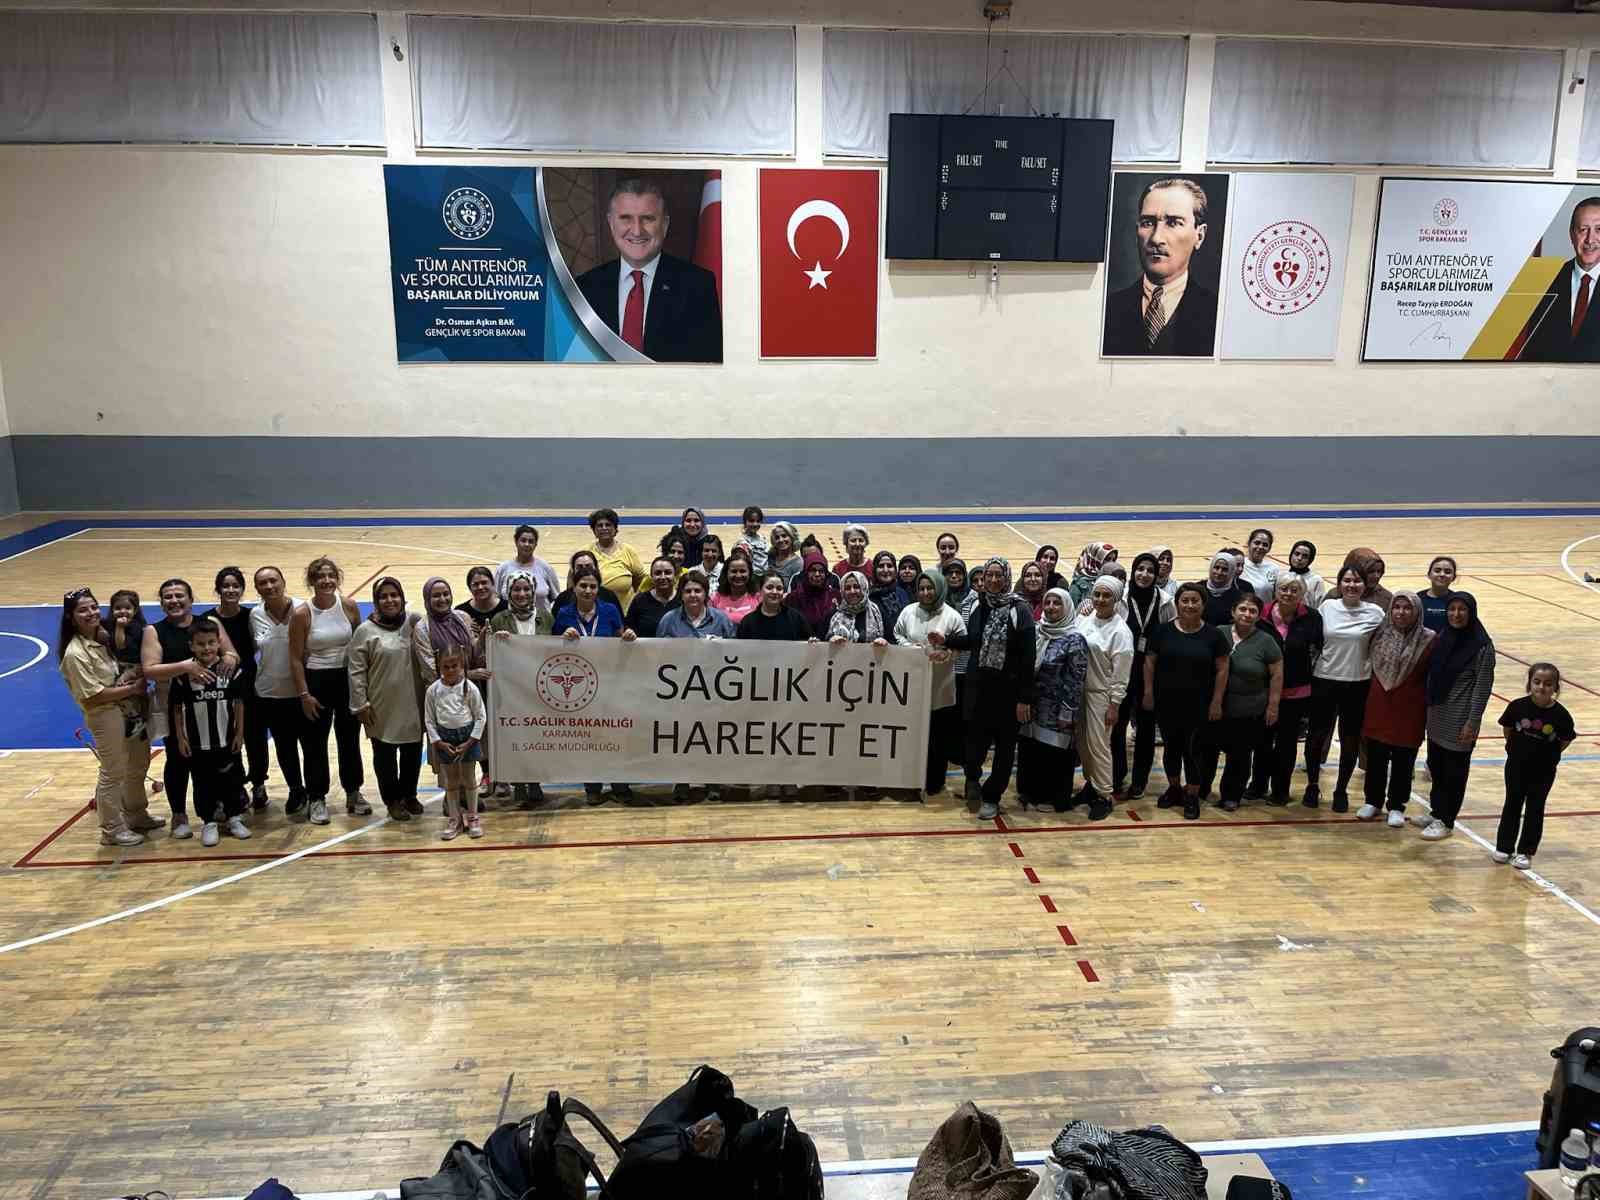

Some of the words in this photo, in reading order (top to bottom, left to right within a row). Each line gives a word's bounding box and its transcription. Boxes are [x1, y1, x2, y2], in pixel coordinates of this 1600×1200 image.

[415, 257, 448, 272] TÜM
[451, 258, 527, 273] ANTRENÖR
[1387, 252, 1412, 266] TÜM
[1415, 253, 1477, 267] ANTRENÖR
[1480, 255, 1494, 267] VE
[400, 273, 418, 286] VE
[421, 273, 544, 287] SPORCULARIMIZA
[1388, 267, 1488, 280] SPORCULARIMIZA
[1380, 281, 1436, 293] BAŞARILAR
[1438, 280, 1493, 292] DİLİYORUM
[407, 290, 472, 302] BAŞARILAR
[474, 288, 540, 301] DİLİYORUM
[1397, 300, 1417, 308] Recep
[1418, 300, 1439, 309] Tayyip
[1440, 299, 1473, 308] ERDOĞAN
[435, 318, 447, 326] Dr.
[448, 318, 475, 326] Osman
[476, 318, 498, 327] Aşkın
[498, 318, 515, 326] BAK
[424, 328, 460, 338] GENÇLİK
[472, 329, 495, 337] SPOR
[496, 329, 526, 337] BAKANI
[656, 655, 810, 702] SAĞLIK
[825, 660, 909, 712] İÇİN
[196, 690, 225, 700] Jeep
[499, 717, 520, 727] T.C.
[522, 716, 568, 727] SAĞLIK
[568, 717, 633, 728] BAKANLIĞI
[542, 730, 591, 738] KARAMAN
[653, 721, 845, 757] HAREKET
[859, 724, 907, 759] ET
[522, 742, 555, 752] SAĞLIK
